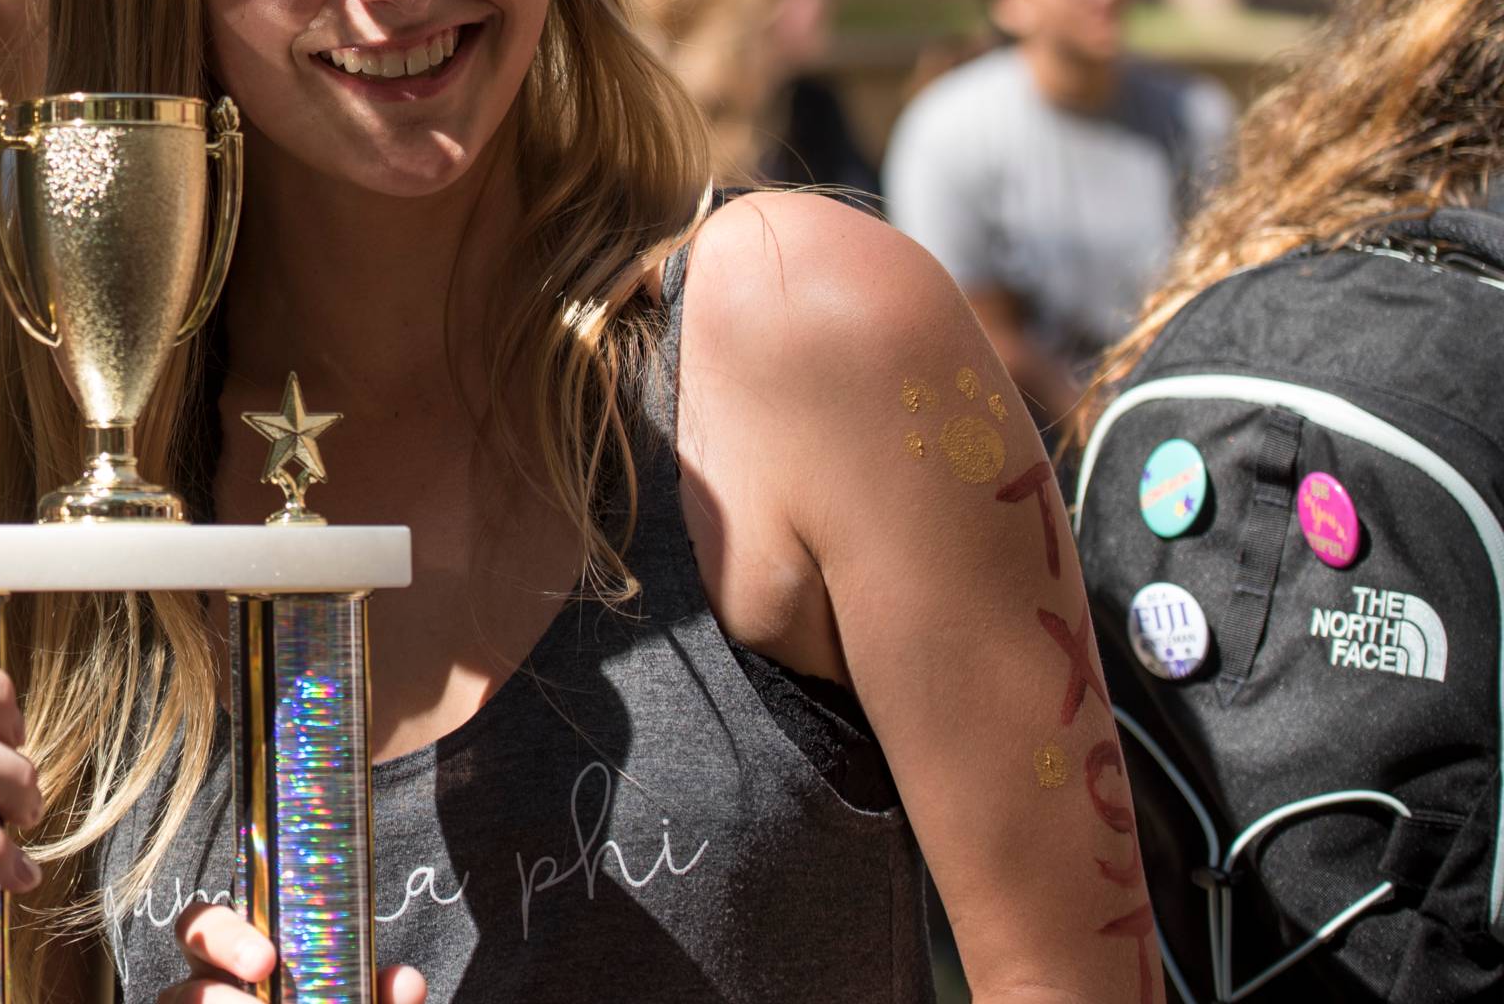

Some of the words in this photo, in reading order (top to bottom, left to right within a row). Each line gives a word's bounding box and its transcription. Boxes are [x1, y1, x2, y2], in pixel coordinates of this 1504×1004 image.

[1133, 602, 1189, 636] FIJI
[1351, 585, 1405, 619] THE
[1310, 607, 1400, 646] NORTH
[1329, 638, 1397, 673] FACE
[515, 761, 710, 941] phi
